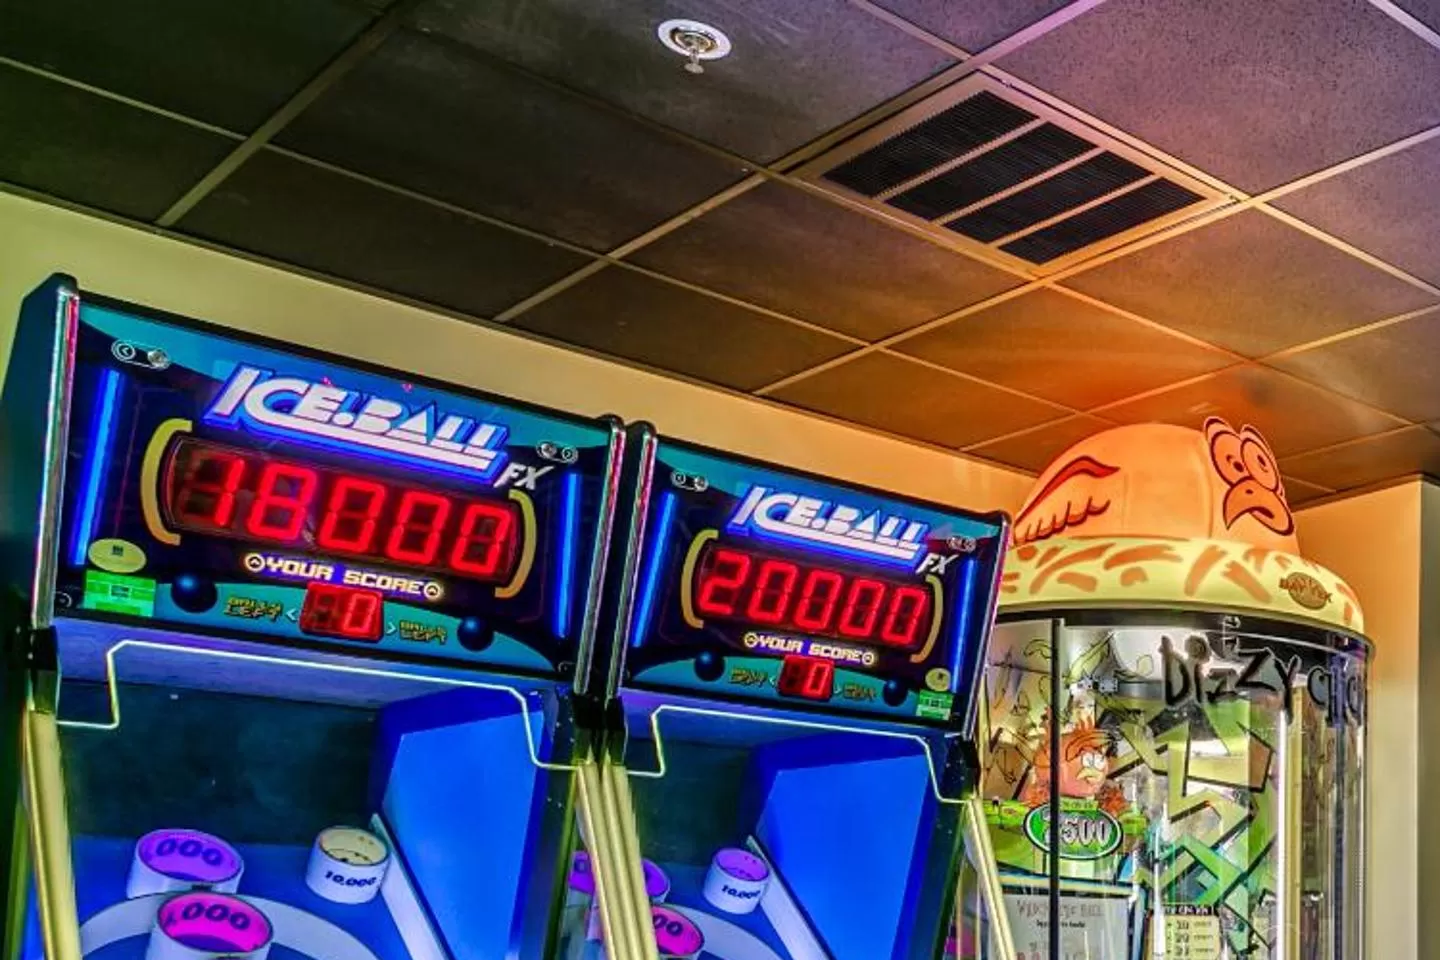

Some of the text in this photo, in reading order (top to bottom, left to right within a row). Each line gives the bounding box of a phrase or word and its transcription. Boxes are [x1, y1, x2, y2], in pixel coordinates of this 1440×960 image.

[213, 459, 513, 576] 18000
[266, 556, 425, 594] YOUR SCORE
[699, 550, 928, 645] 20000
[759, 634, 862, 662] YOUR SCORE
